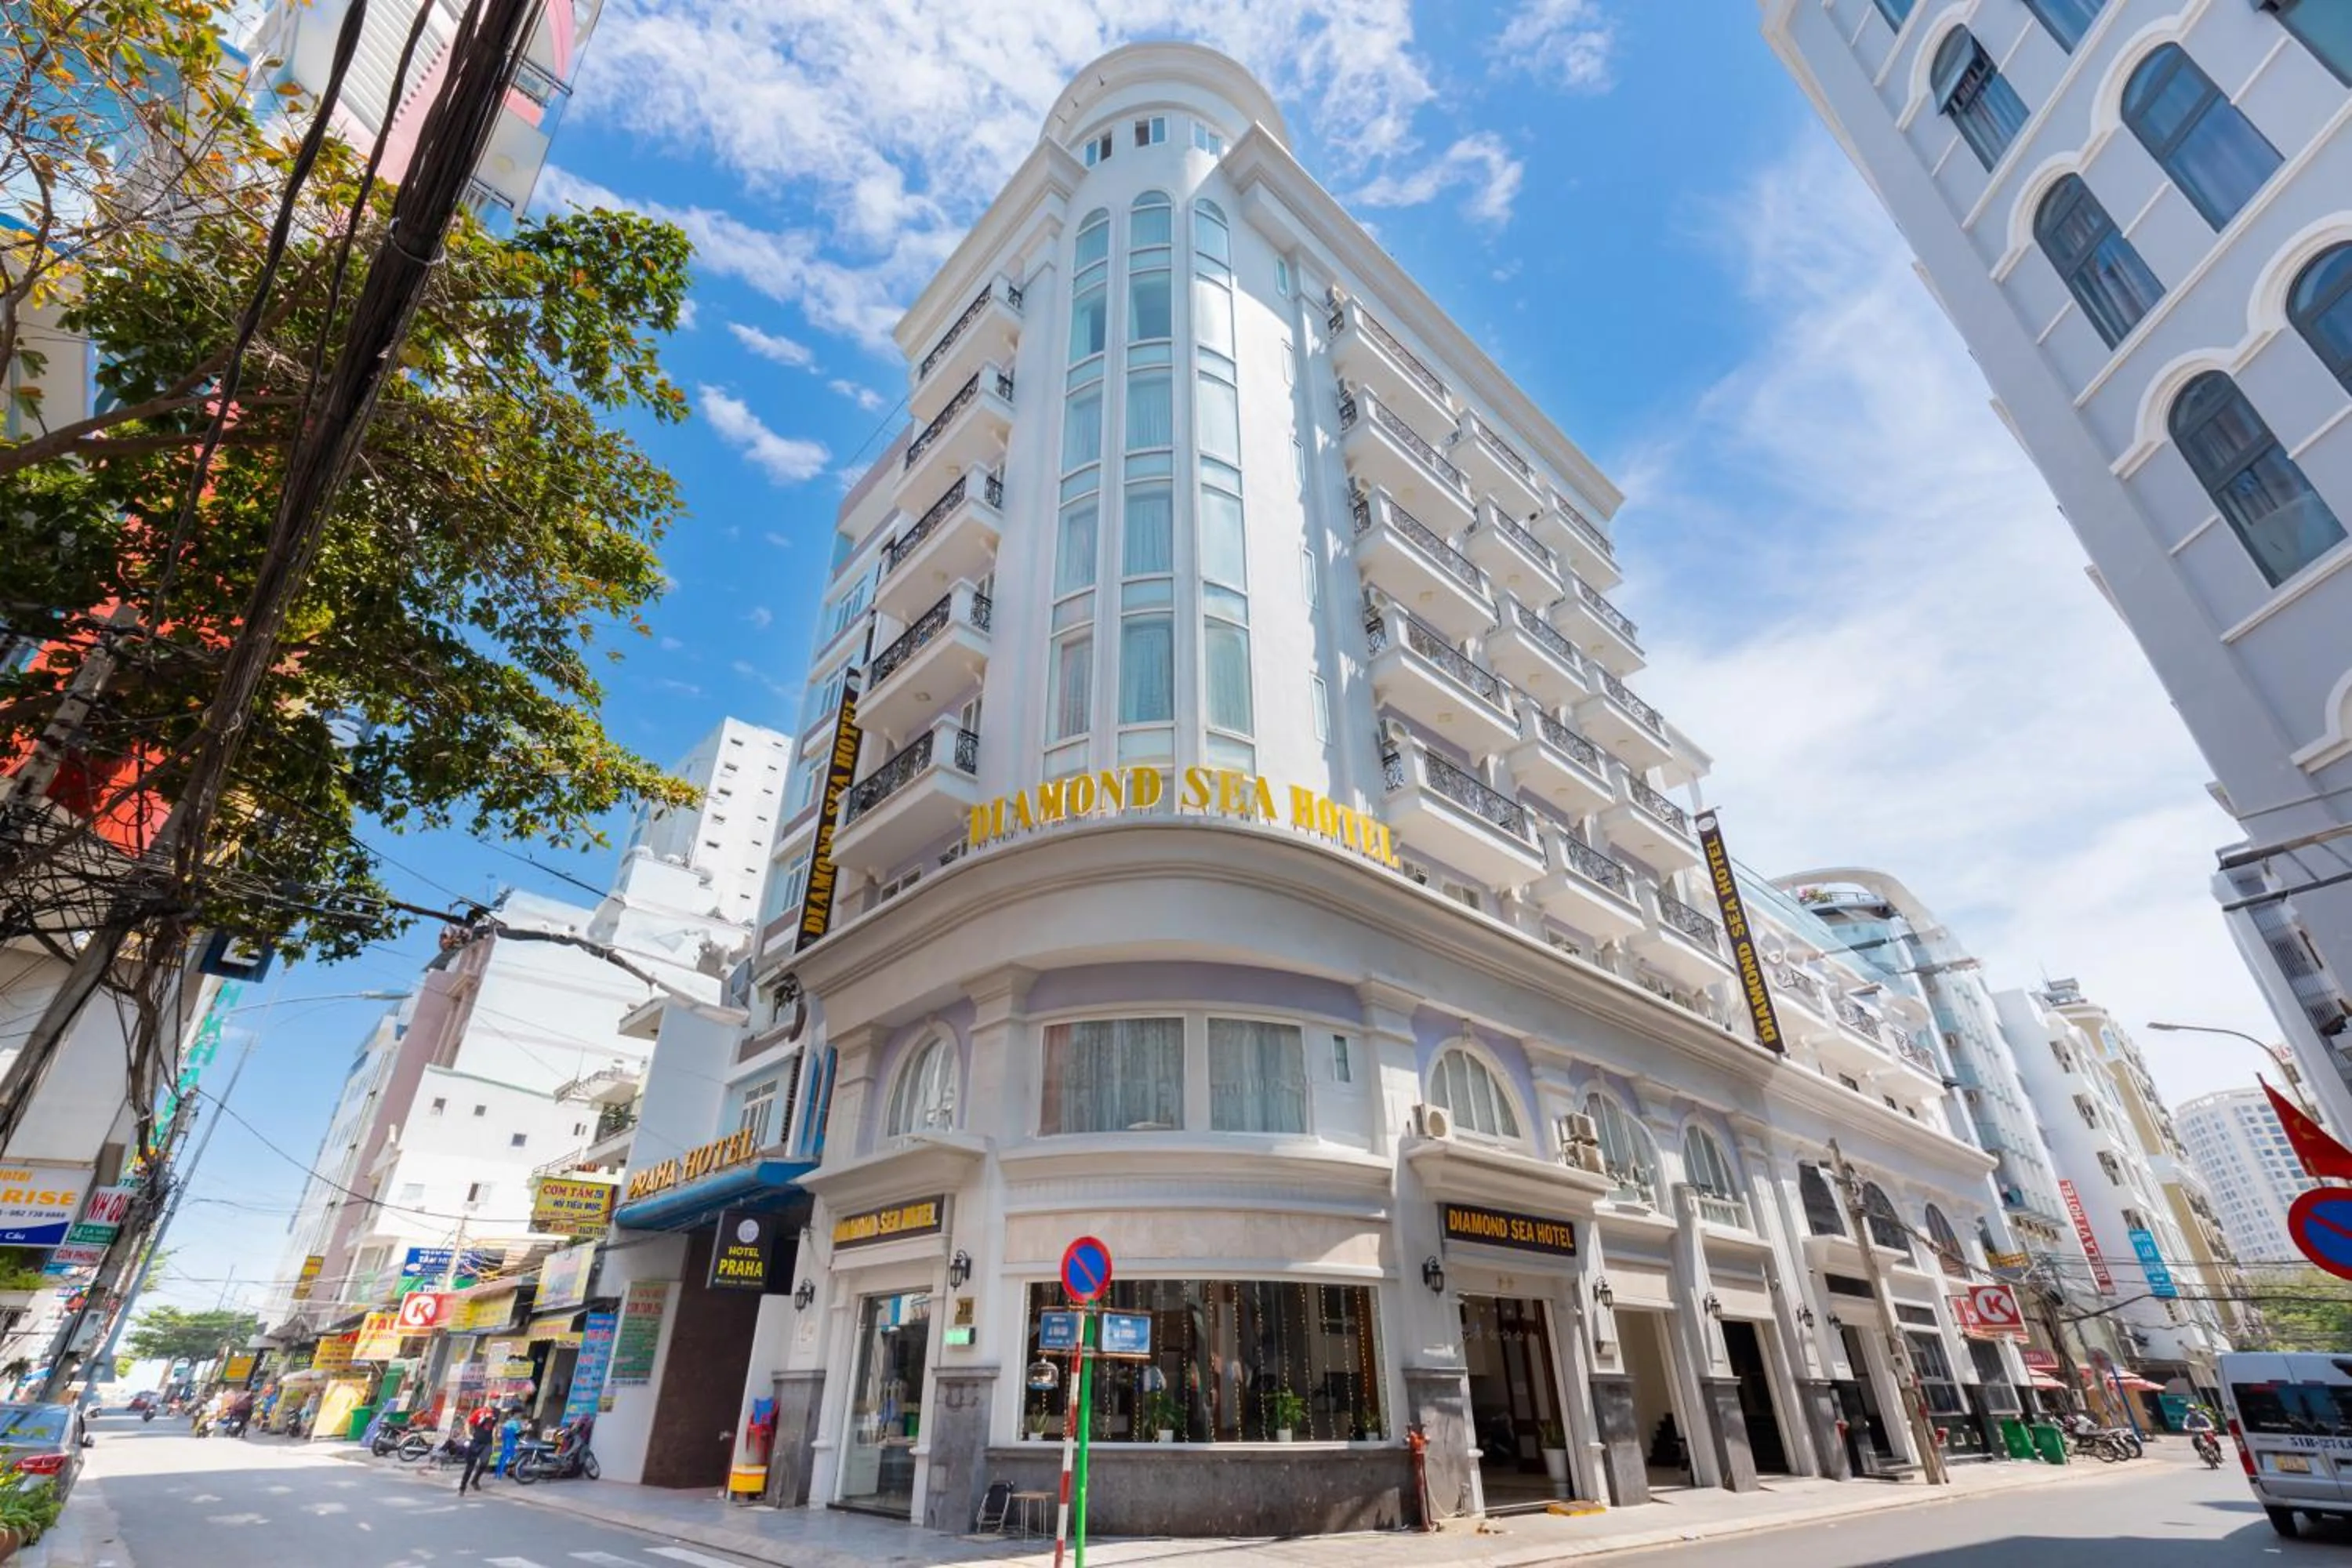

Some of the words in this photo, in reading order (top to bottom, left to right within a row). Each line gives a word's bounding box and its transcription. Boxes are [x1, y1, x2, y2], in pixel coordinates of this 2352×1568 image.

[968, 767, 1162, 845] DIAMOND
[1181, 768, 1278, 820] SEA
[1289, 784, 1400, 869] HOTEL
[1706, 833, 1733, 896] HOTEL
[1724, 898, 1746, 938] SEA
[1737, 942, 1777, 1044] DIAMOND
[627, 1157, 677, 1200] PRAHA
[682, 1128, 755, 1179] HOTEL
[832, 1214, 878, 1243] DIAMOND
[880, 1210, 901, 1235] SEA
[902, 1201, 938, 1229] HOTEL
[1448, 1210, 1508, 1238] DIAMOND
[1511, 1219, 1535, 1243] SEA
[1537, 1222, 1574, 1248] HOTEL
[717, 1258, 763, 1277] PRAHA
[728, 1245, 760, 1258] HOTEL
